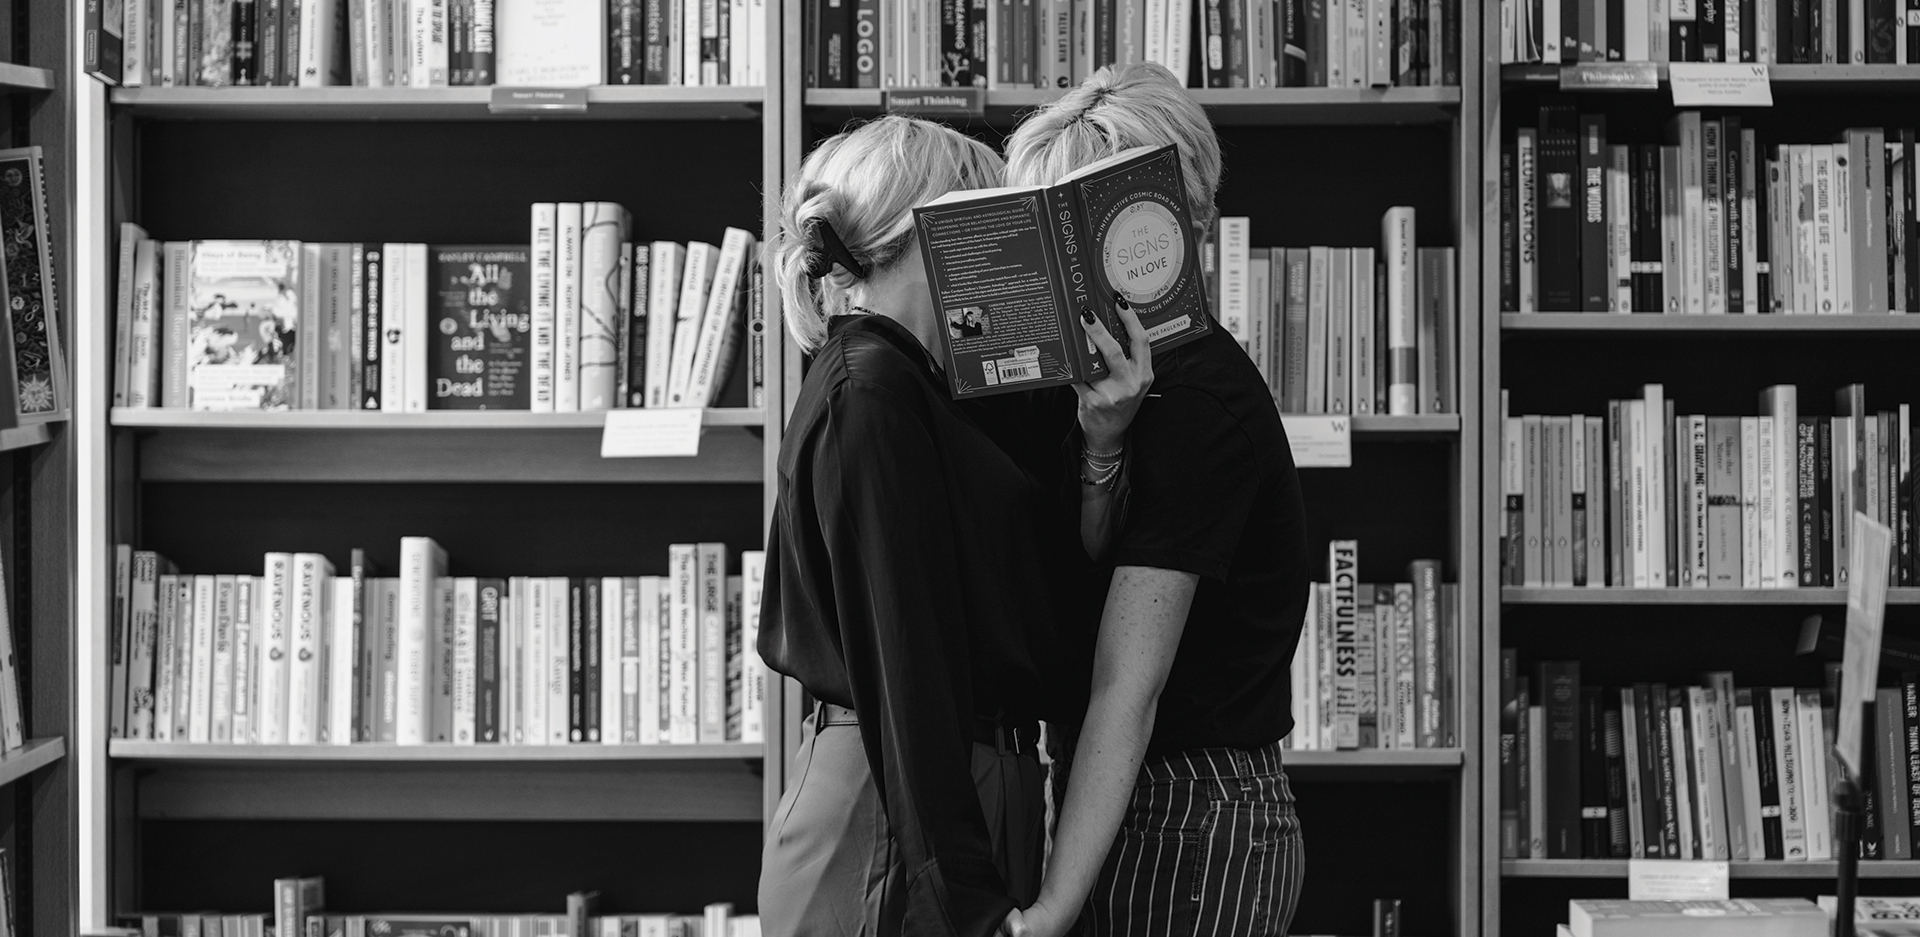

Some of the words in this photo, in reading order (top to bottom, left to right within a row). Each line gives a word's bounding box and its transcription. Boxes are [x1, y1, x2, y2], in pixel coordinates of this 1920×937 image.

[1058, 12, 1068, 36] TALIA
[857, 8, 874, 73] LOGO
[1058, 39, 1068, 63] LAVIN
[1582, 71, 1634, 83] Philosophy
[1751, 66, 1765, 76] W
[890, 96, 920, 106] Smart
[922, 96, 968, 107] Thinking
[1706, 126, 1720, 147] HOW
[1706, 147, 1720, 161] TO
[1587, 167, 1602, 188] THE
[1706, 161, 1720, 187] THINK
[1728, 150, 1740, 202] Conspiring
[1818, 159, 1830, 176] THE
[1057, 201, 1069, 209] THE
[1523, 147, 1536, 265] ILLUMINATIONS
[1587, 187, 1602, 223] WOODS
[1706, 188, 1720, 204] LIKE
[1818, 177, 1830, 211] SCHOOL
[970, 217, 1000, 226] RELATIONSHIPS
[1010, 212, 1030, 220] ROMANTIC
[982, 210, 1012, 218] ASTROLOGICAL
[1096, 232, 1102, 242] AN
[1099, 197, 1129, 231] INTERACTIVE
[1129, 192, 1152, 200] COSMIC
[1154, 192, 1170, 203] ROAD
[1170, 200, 1180, 212] MAP
[1706, 204, 1720, 212] A
[1728, 201, 1740, 225] with
[1818, 213, 1830, 225] OF
[1059, 210, 1078, 255] SIGNS
[1132, 226, 1149, 238] THE
[1728, 224, 1740, 237] the
[1744, 189, 1757, 253] Metamorphoses
[538, 226, 552, 244] ALL
[932, 230, 961, 238] CONNECTIONS
[1618, 221, 1630, 257] Truth
[1706, 212, 1720, 273] PHILOSOPHER
[1818, 225, 1830, 245] LIFE
[476, 252, 528, 262] CAMPBELL
[538, 250, 552, 268] THE
[1117, 233, 1170, 266] SIGNS
[1205, 243, 1215, 273] SURVIVE
[1728, 237, 1740, 271] Enemy
[173, 249, 186, 312] Humankind
[468, 264, 498, 286] All
[1126, 268, 1138, 281] IN
[1140, 256, 1168, 276] LOVE
[1070, 263, 1088, 303] LOVE
[1148, 304, 1162, 313] LOVE
[1162, 293, 1175, 306] THAT
[1174, 277, 1187, 295] LASTS
[468, 287, 498, 306] the
[469, 308, 530, 333] Living
[1160, 320, 1188, 334] FAULKNER
[451, 332, 485, 351] and
[538, 326, 552, 345] AND
[456, 354, 485, 374] the
[538, 352, 552, 372] THE
[436, 378, 484, 397] Dead
[538, 375, 552, 403] DEAD
[1331, 420, 1347, 433] W
[1799, 423, 1807, 437] OF
[1807, 424, 1815, 445] THE
[1799, 439, 1807, 500] KNOWLEDGE
[1807, 446, 1815, 498] FRONTIERS
[1803, 523, 1812, 570] GRAYLING
[704, 553, 719, 575] THE
[1424, 567, 1434, 590] How
[217, 582, 232, 614] Evan
[272, 560, 284, 641] RAVENOUS
[301, 560, 314, 641] RAVENOUS
[385, 591, 397, 622] danny
[482, 586, 498, 623] GRIT
[704, 579, 719, 613] URGE
[1336, 548, 1355, 677] FACTFULNESS
[217, 615, 232, 654] Davis
[385, 625, 397, 661] dorling
[704, 616, 719, 650] CARL
[1397, 591, 1413, 675] CONTROL
[704, 652, 719, 680] ERIK
[704, 682, 719, 726] FISHER
[1908, 725, 1919, 753] THINK
